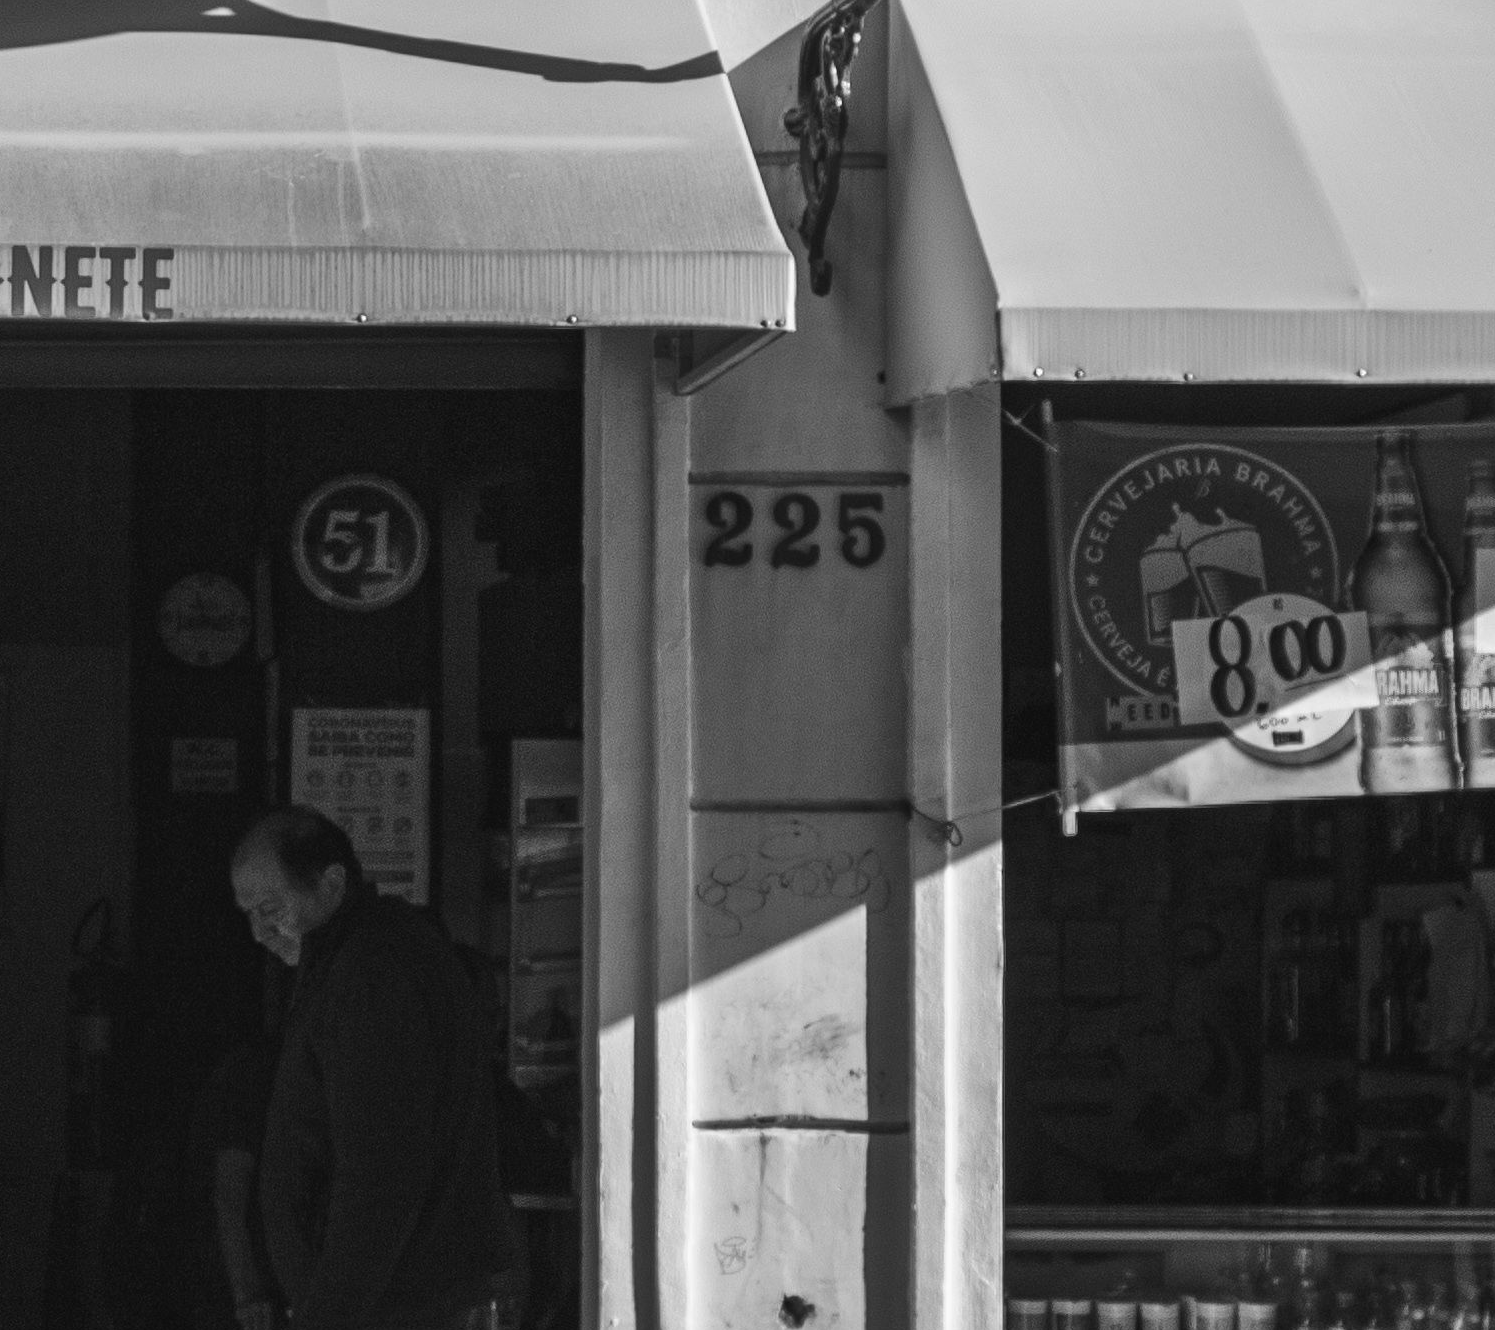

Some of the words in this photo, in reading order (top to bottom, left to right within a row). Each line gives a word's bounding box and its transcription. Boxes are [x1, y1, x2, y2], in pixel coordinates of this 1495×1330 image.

[320, 509, 398, 575] 51
[702, 490, 887, 570] 225
[1084, 456, 1223, 564] CERVEJARIA
[1233, 461, 1322, 557] BRAHMA
[1088, 592, 1153, 680] CERVEJA
[1376, 669, 1440, 697] RAHMA
